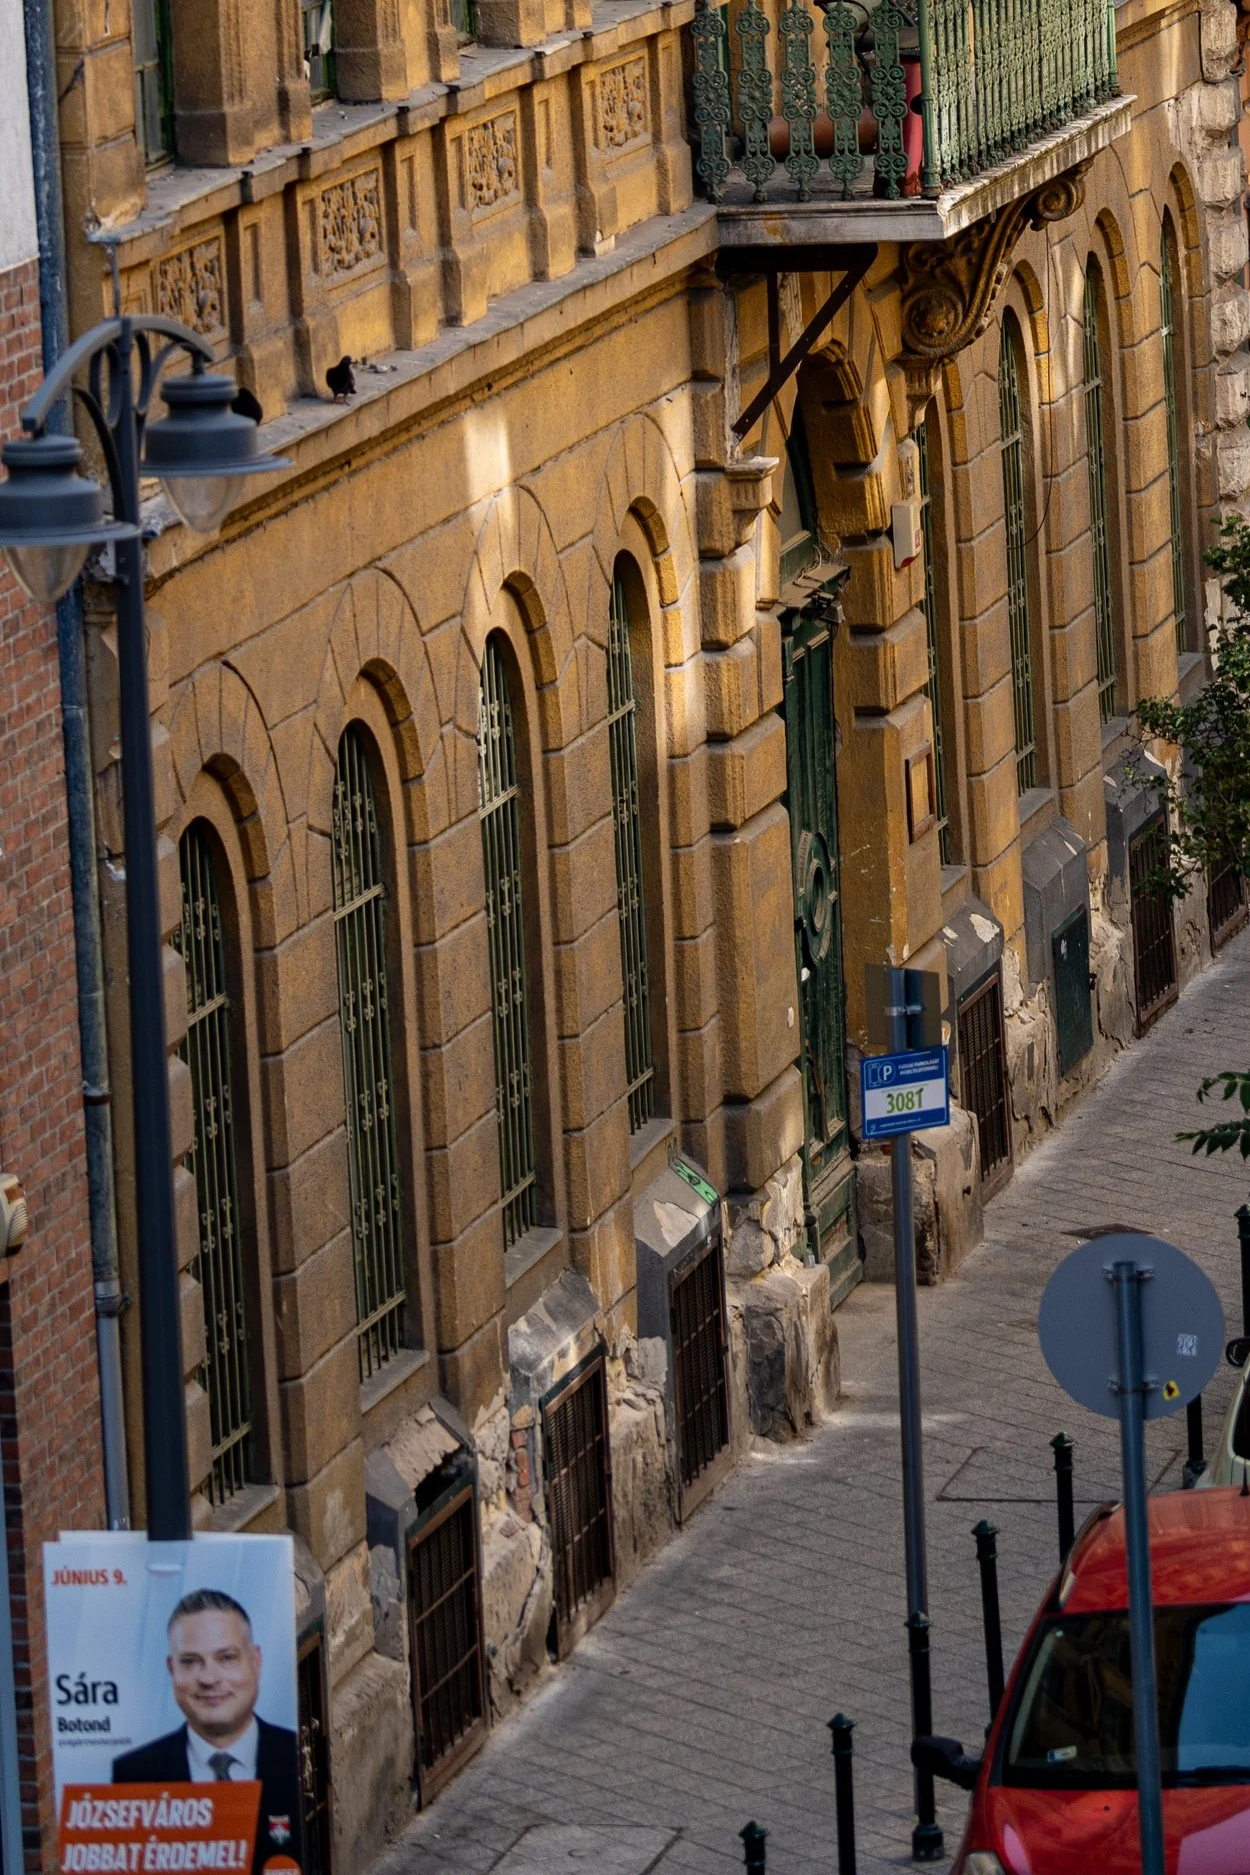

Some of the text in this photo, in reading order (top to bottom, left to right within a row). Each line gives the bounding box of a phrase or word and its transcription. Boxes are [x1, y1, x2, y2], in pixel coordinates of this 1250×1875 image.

[883, 1065, 893, 1081] P
[886, 1087, 924, 1114] 3081
[52, 1565, 127, 1586] JÚNIUS 9.
[56, 1671, 119, 1705] Sára
[57, 1715, 111, 1733] Botond
[66, 1791, 214, 1830] JÓZSEFVÁROS
[61, 1834, 248, 1872] JOBBAT ÉRDEMEL!
